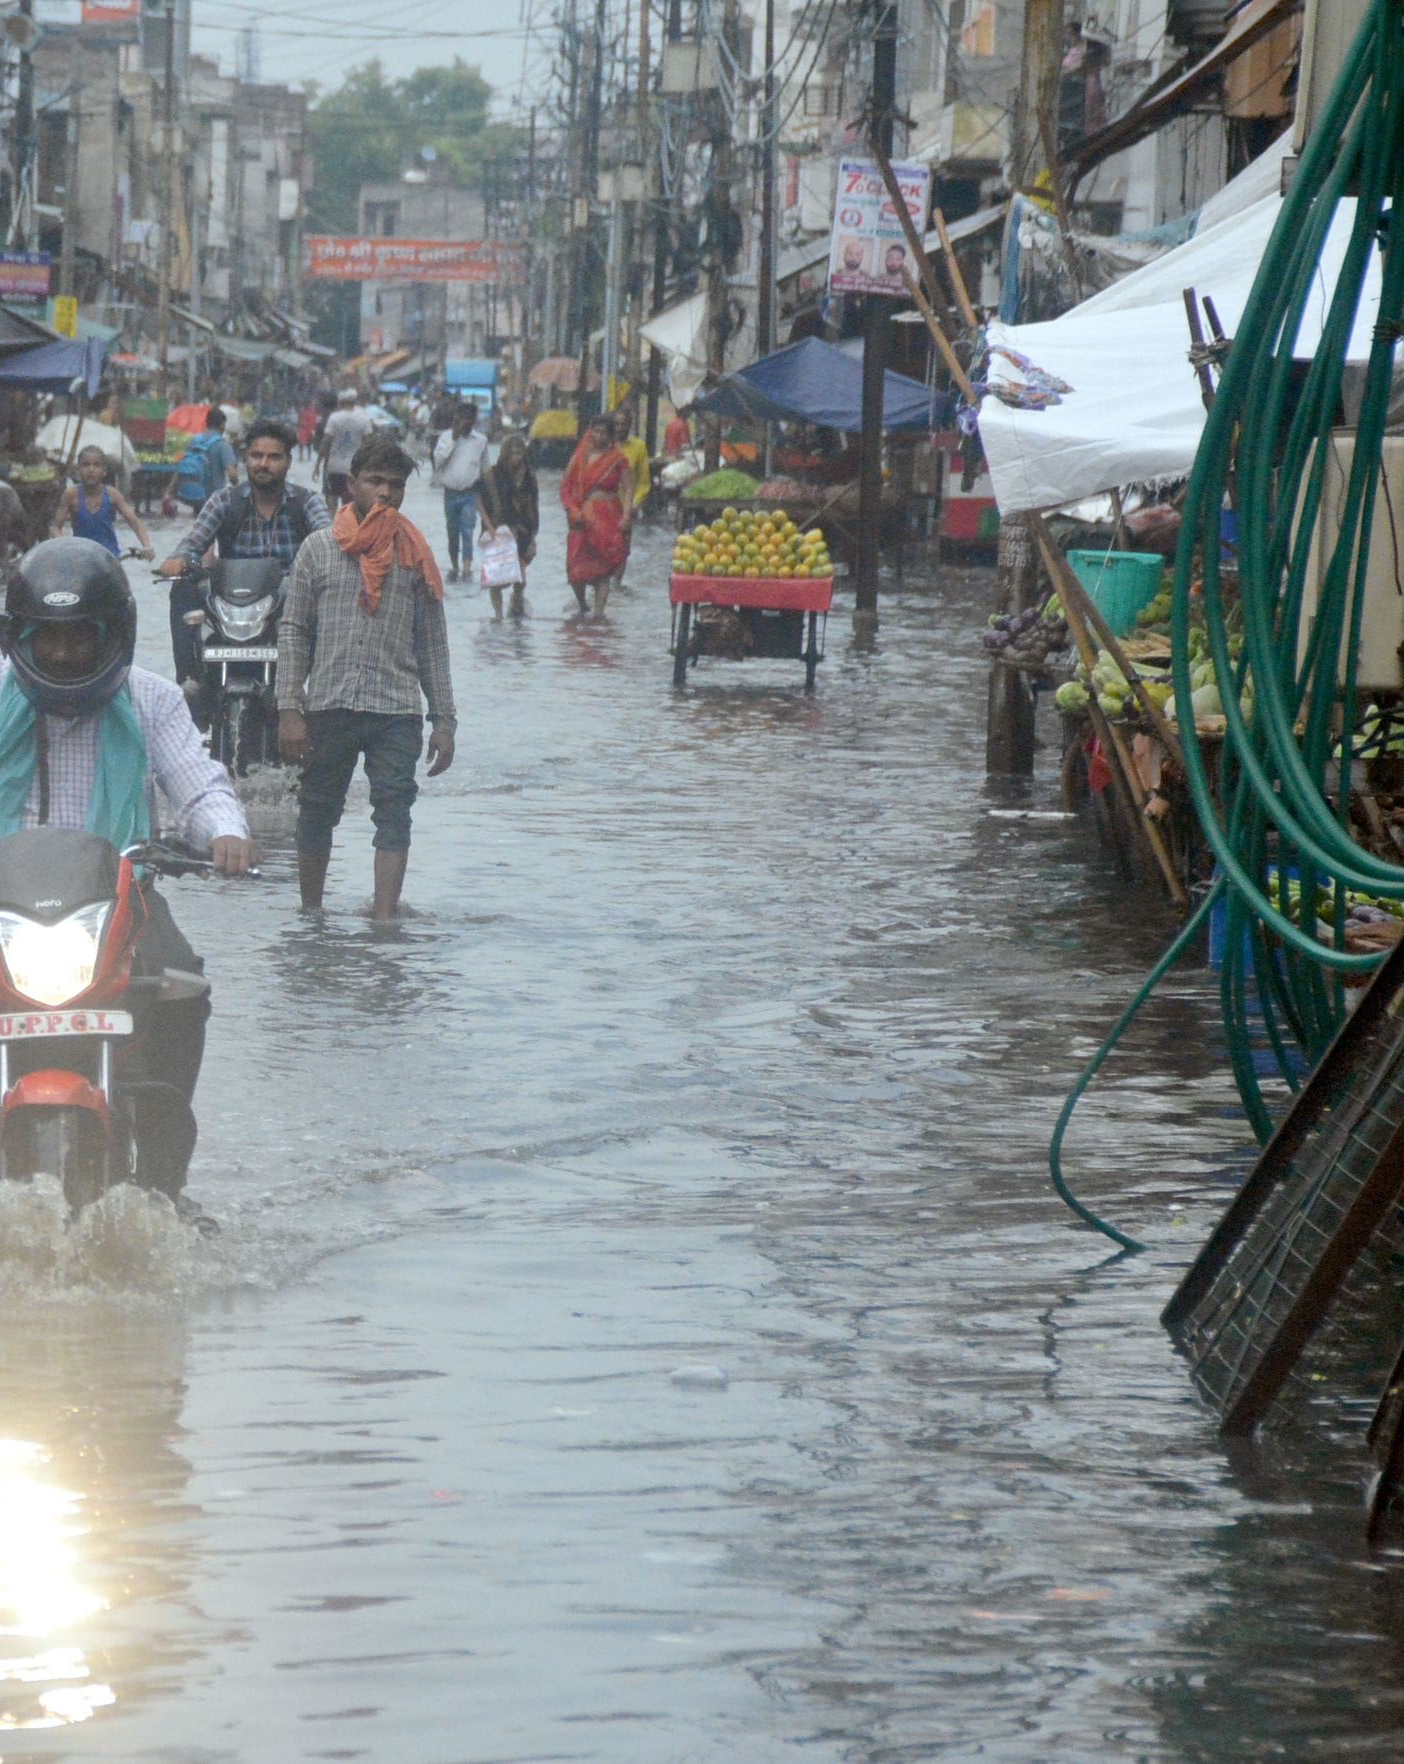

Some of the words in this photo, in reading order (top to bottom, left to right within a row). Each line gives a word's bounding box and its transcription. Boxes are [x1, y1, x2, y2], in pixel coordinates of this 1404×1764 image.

[845, 172, 862, 193] 7
[855, 176, 922, 198] O'CLCK
[35, 900, 62, 909] Hero
